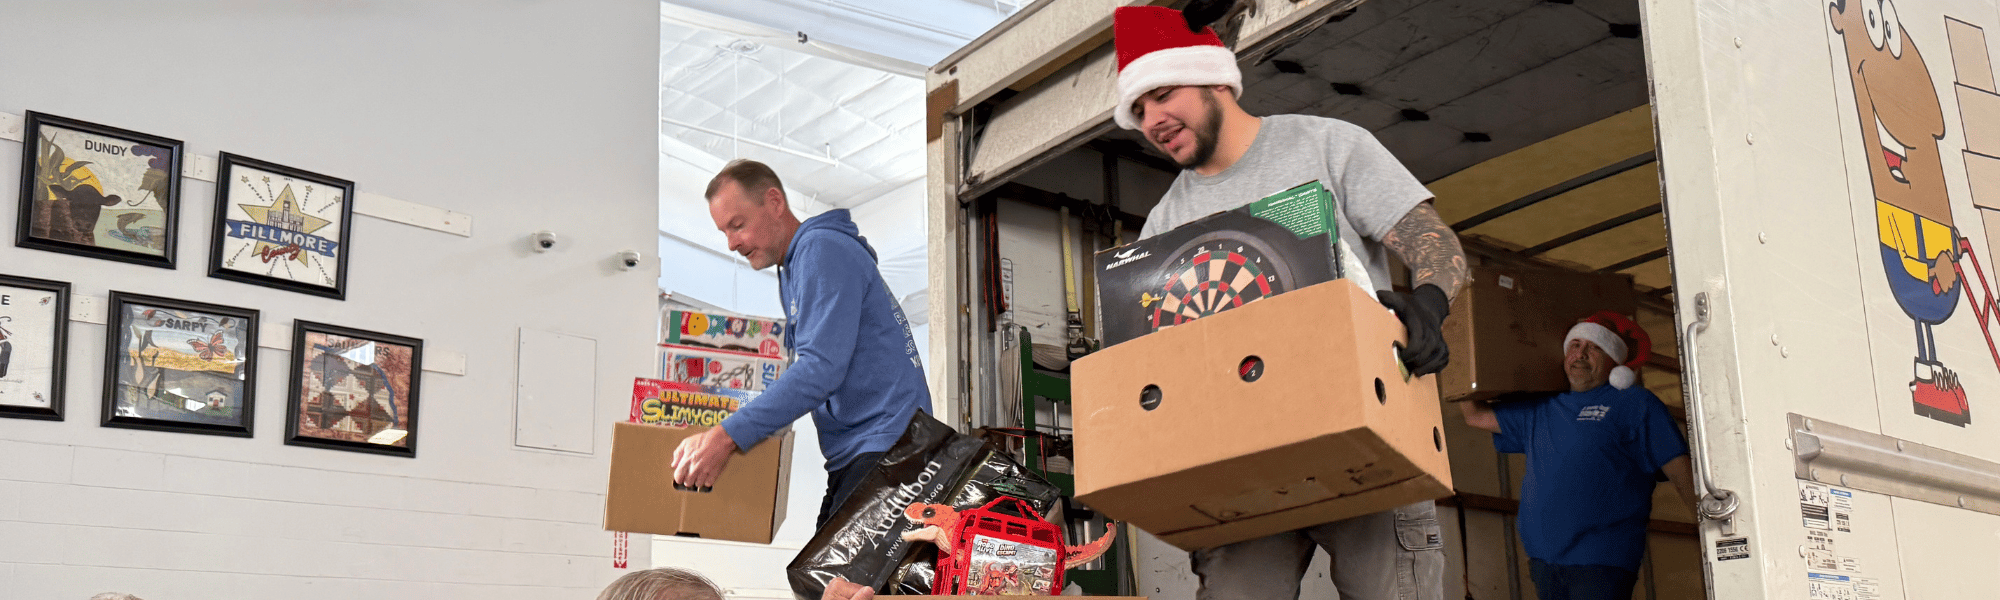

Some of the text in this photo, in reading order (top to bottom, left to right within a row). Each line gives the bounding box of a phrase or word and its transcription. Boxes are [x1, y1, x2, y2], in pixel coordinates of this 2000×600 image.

[84, 139, 128, 157] DUNDY
[240, 223, 328, 252] FILLMORE
[261, 243, 300, 264] County
[1105, 250, 1153, 271] NARWHAL
[165, 317, 208, 333] SARPY
[641, 398, 734, 427] SLIMYGLO
[660, 390, 740, 413] ULTIMATE
[863, 460, 942, 550] Audubon
